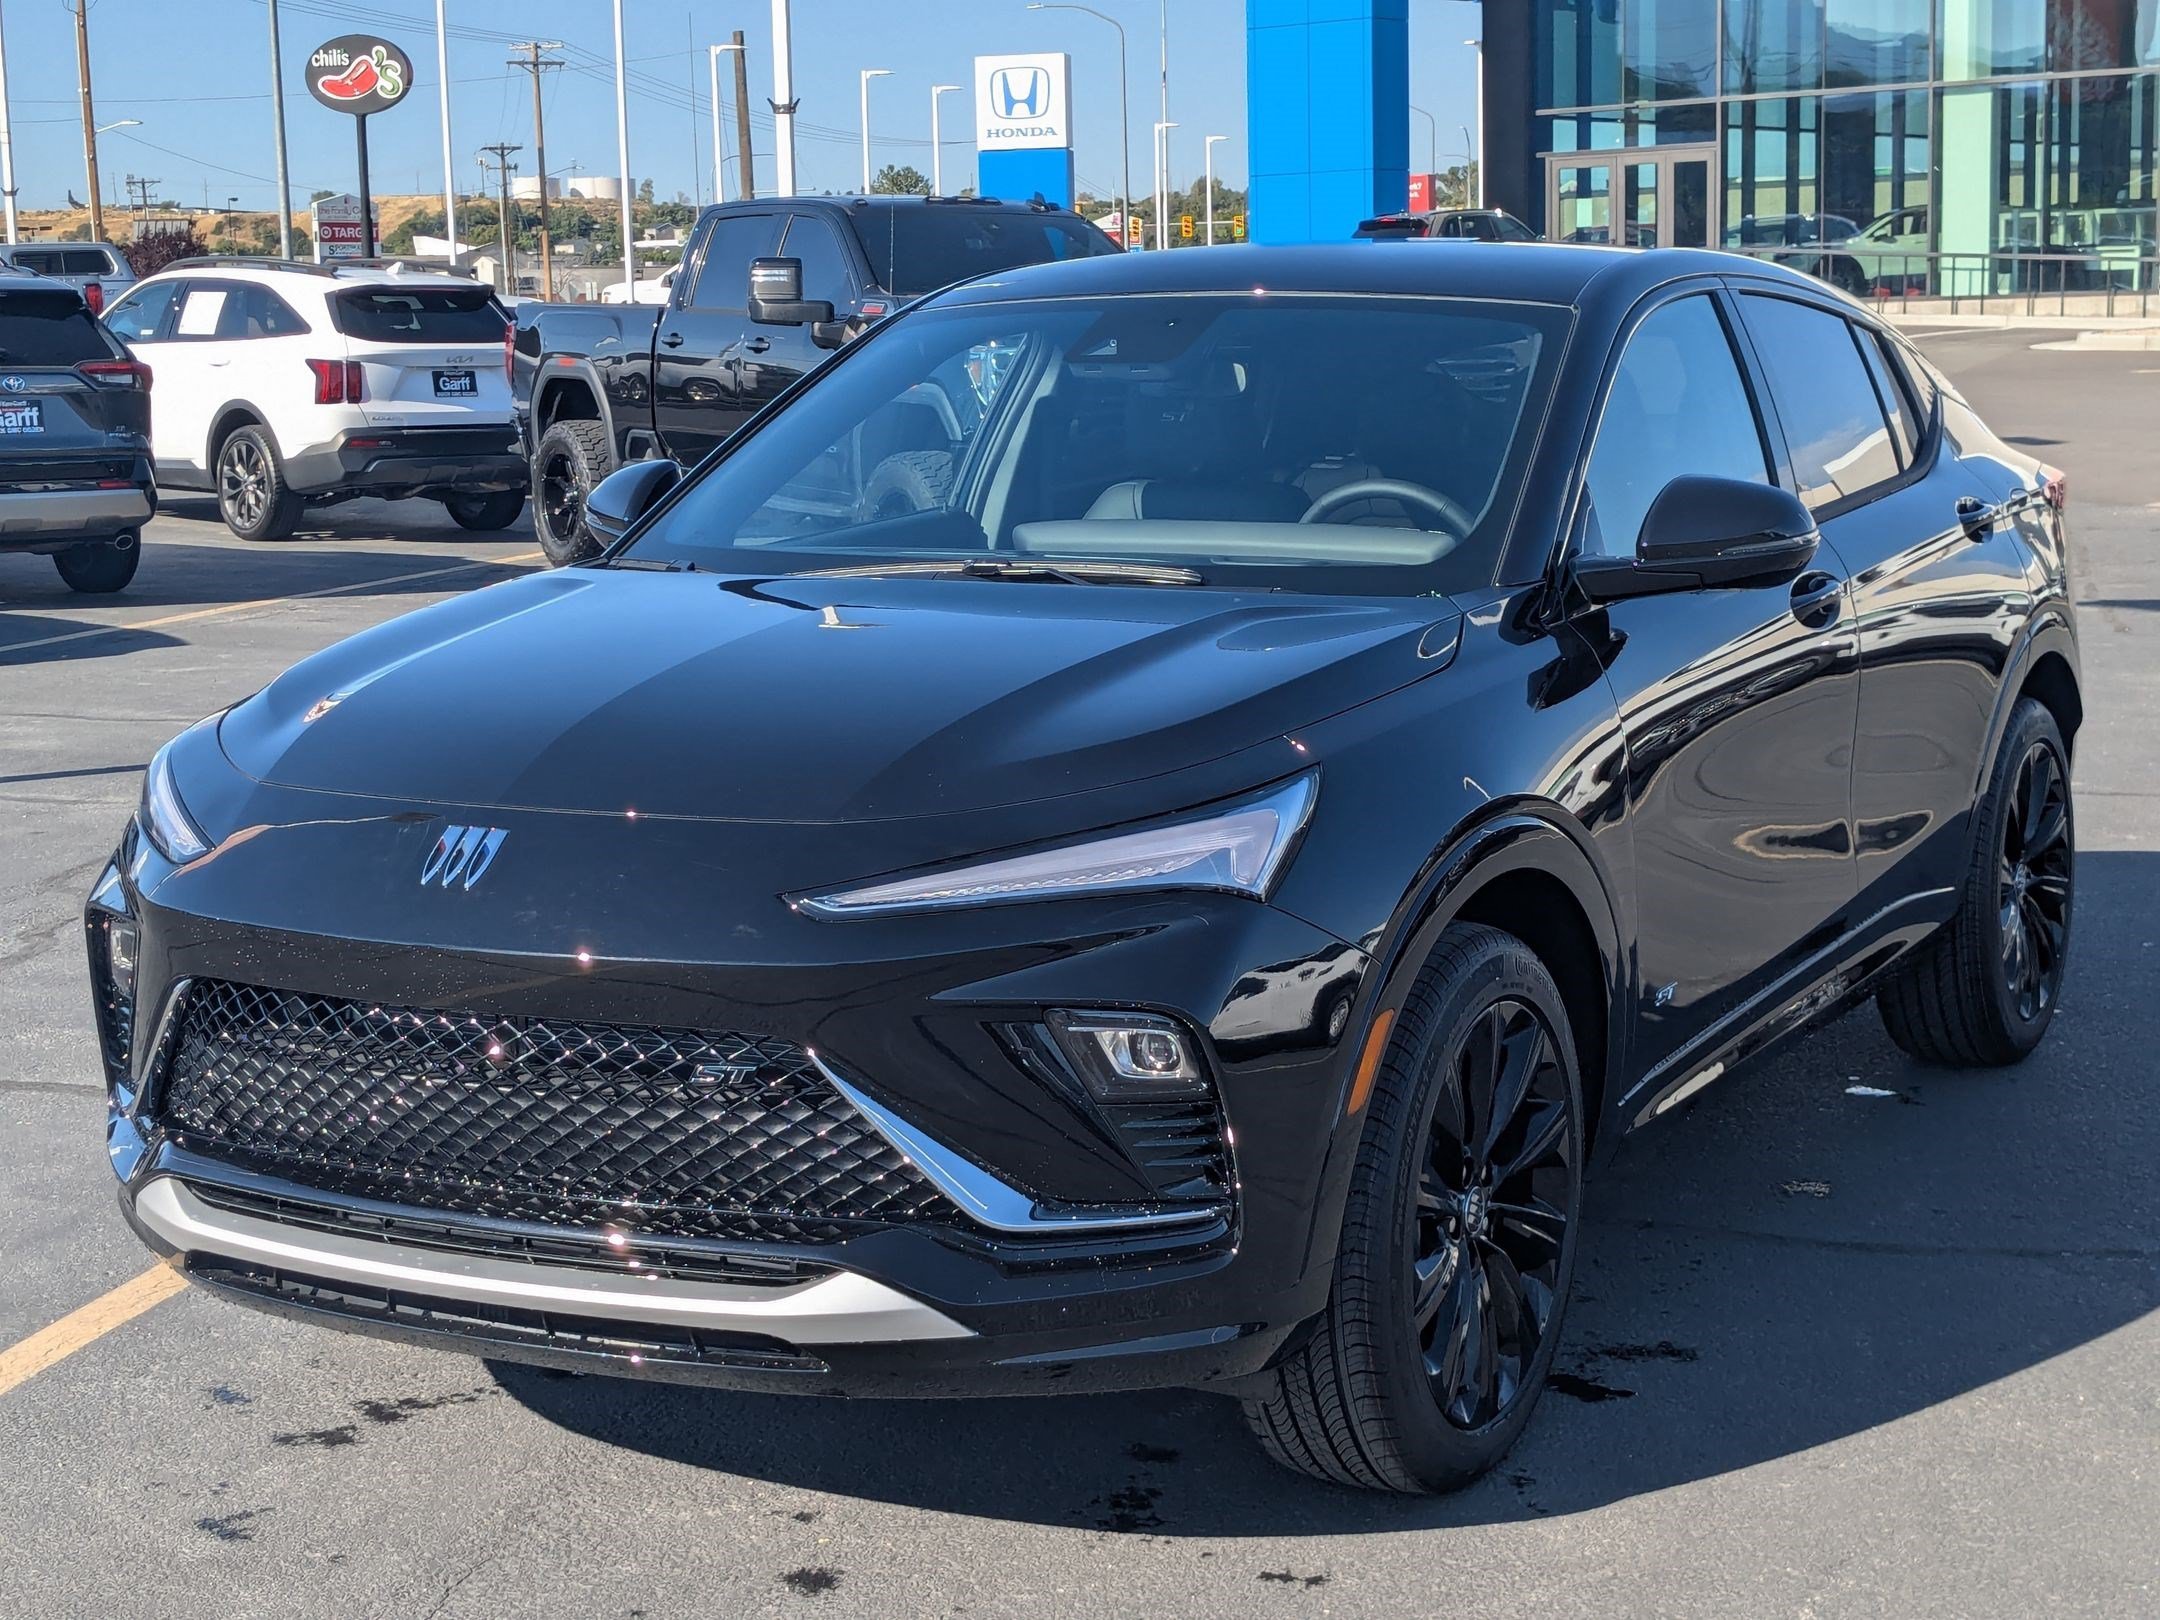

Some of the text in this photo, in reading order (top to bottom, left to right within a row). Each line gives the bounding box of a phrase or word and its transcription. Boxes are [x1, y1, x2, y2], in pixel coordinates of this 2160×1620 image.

[986, 126, 1058, 138] HONDA
[333, 227, 378, 238] TARGT
[439, 376, 471, 391] Garff
[688, 1064, 758, 1084] ST
